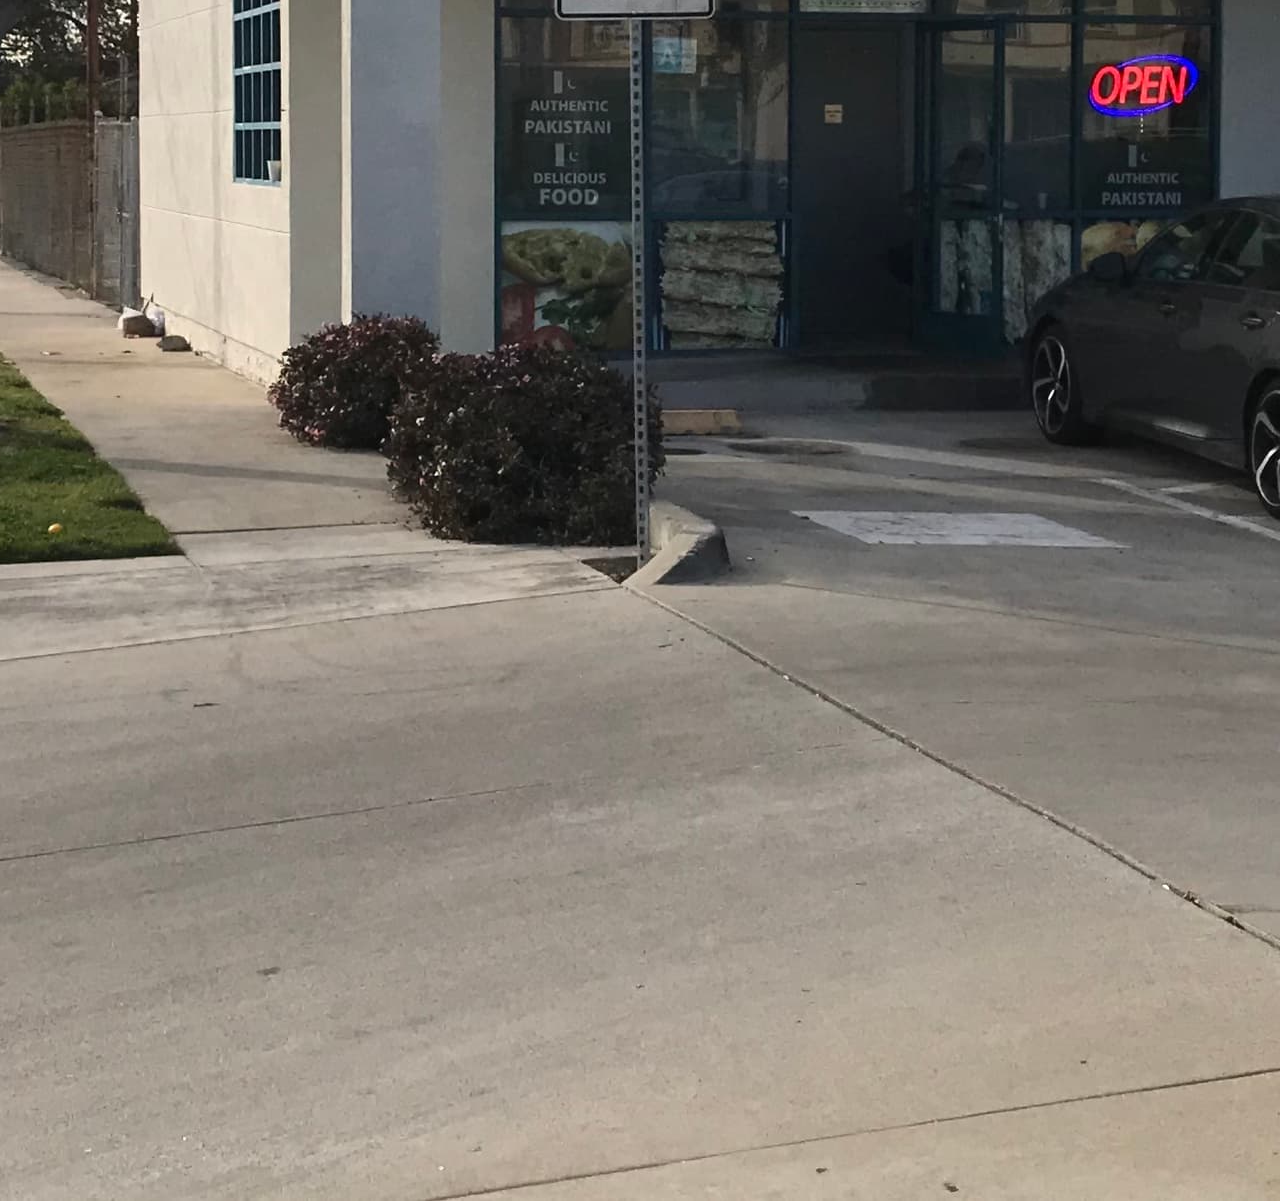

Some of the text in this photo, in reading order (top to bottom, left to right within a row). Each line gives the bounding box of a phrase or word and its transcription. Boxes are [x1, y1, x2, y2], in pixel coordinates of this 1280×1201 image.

[1092, 65, 1188, 105] OPEN
[531, 100, 609, 111] AUTHENTIC
[525, 120, 612, 134] PAKISTANI
[533, 173, 607, 184] DELICIOUS
[1107, 173, 1180, 184] AUTHENTIC
[540, 189, 599, 205] FOOD
[1102, 192, 1182, 206] PAKISTANI
